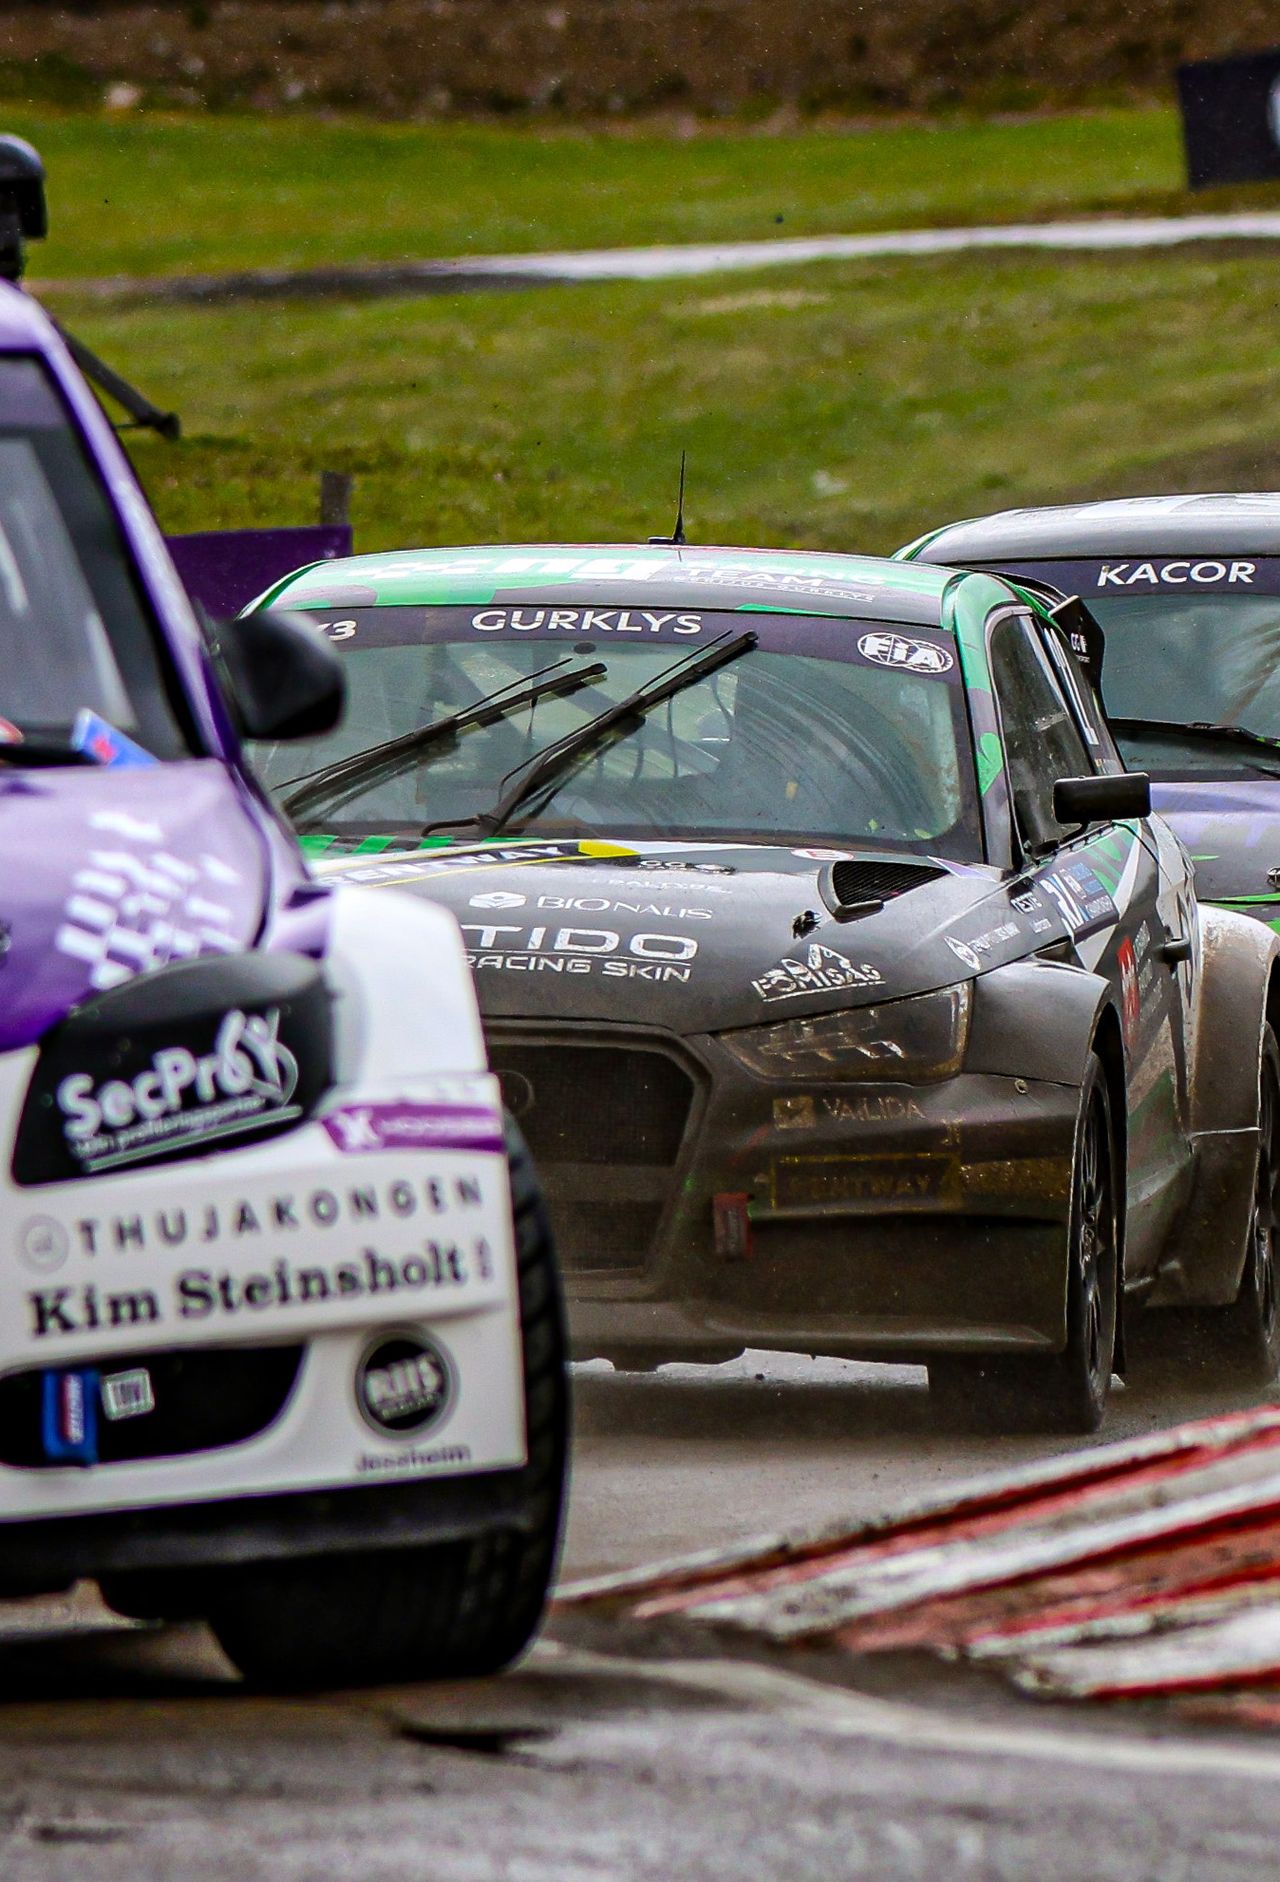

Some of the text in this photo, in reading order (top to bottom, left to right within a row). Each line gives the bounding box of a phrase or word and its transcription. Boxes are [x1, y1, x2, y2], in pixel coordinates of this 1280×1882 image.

[677, 567, 825, 588] TEAM
[1097, 562, 1257, 587] KACOR
[472, 609, 703, 635] GURKLYS
[863, 633, 946, 670] FIA
[536, 896, 714, 921] BIONALIS
[601, 961, 692, 984] SKIN
[77, 1176, 484, 1256] THUJAKONGEN
[28, 1285, 160, 1338] Kim
[177, 1239, 465, 1319] Steinsholt
